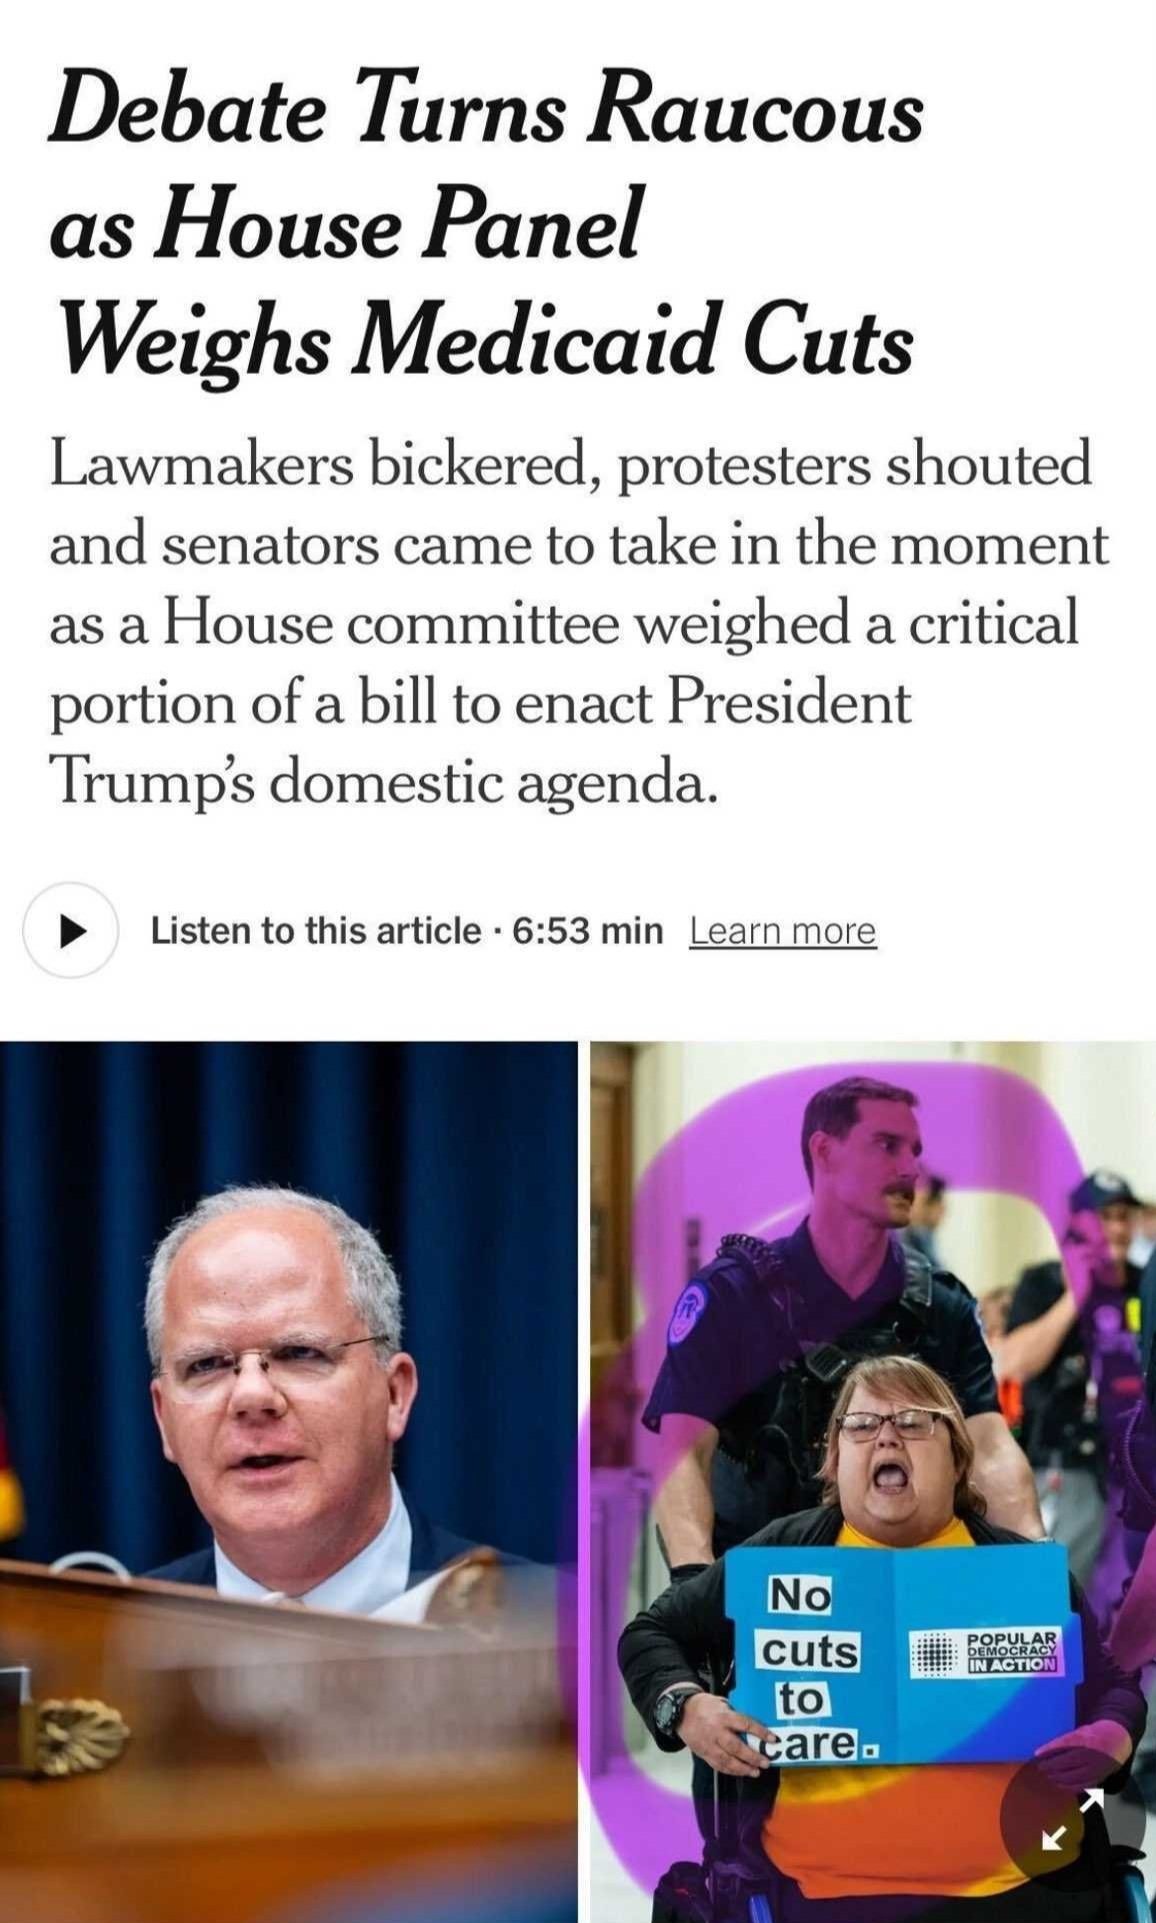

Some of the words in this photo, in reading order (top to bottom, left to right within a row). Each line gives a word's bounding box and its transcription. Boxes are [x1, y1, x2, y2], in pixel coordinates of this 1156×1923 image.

[771, 1577, 831, 1612] No
[762, 1634, 858, 1669] cuts
[967, 1632, 1057, 1647] POPULAR
[967, 1645, 1057, 1657] DEMOCRACY
[969, 1658, 987, 1672] IN
[990, 1657, 1056, 1672] ACTION
[779, 1682, 824, 1715] to
